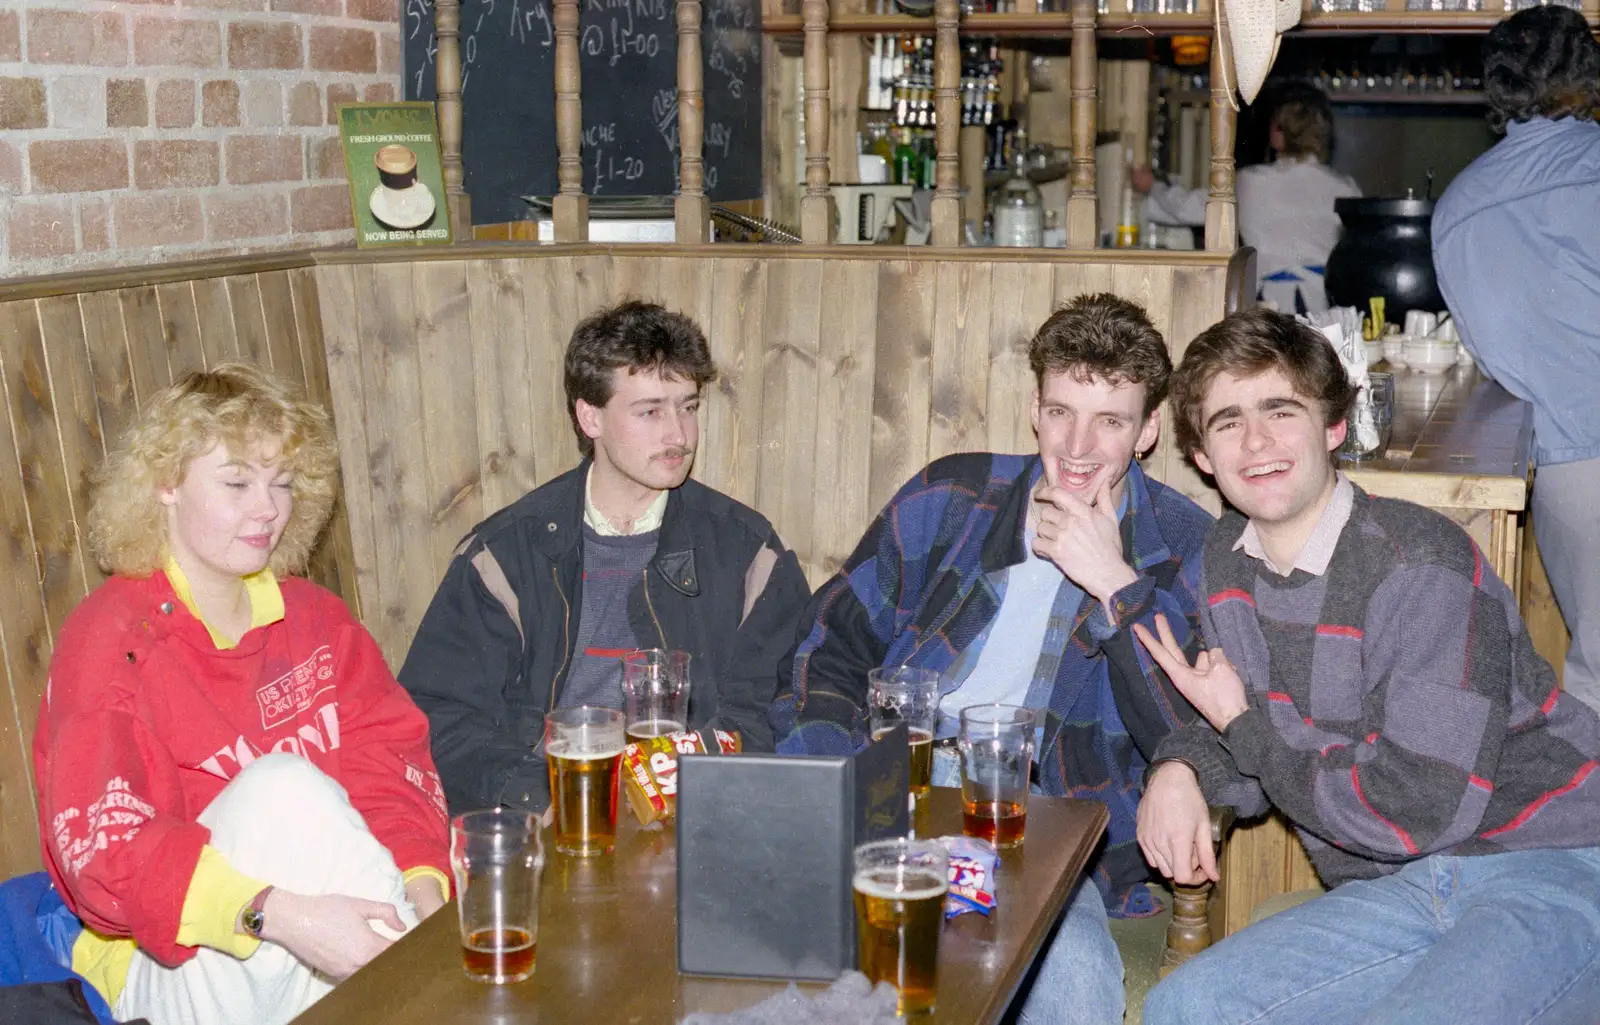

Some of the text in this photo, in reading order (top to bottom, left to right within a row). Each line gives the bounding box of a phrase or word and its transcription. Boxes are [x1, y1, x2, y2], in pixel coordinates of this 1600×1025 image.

[350, 133, 433, 144] FRESH GROUND COFFEE
[365, 229, 448, 242] NOW BEING SERVED
